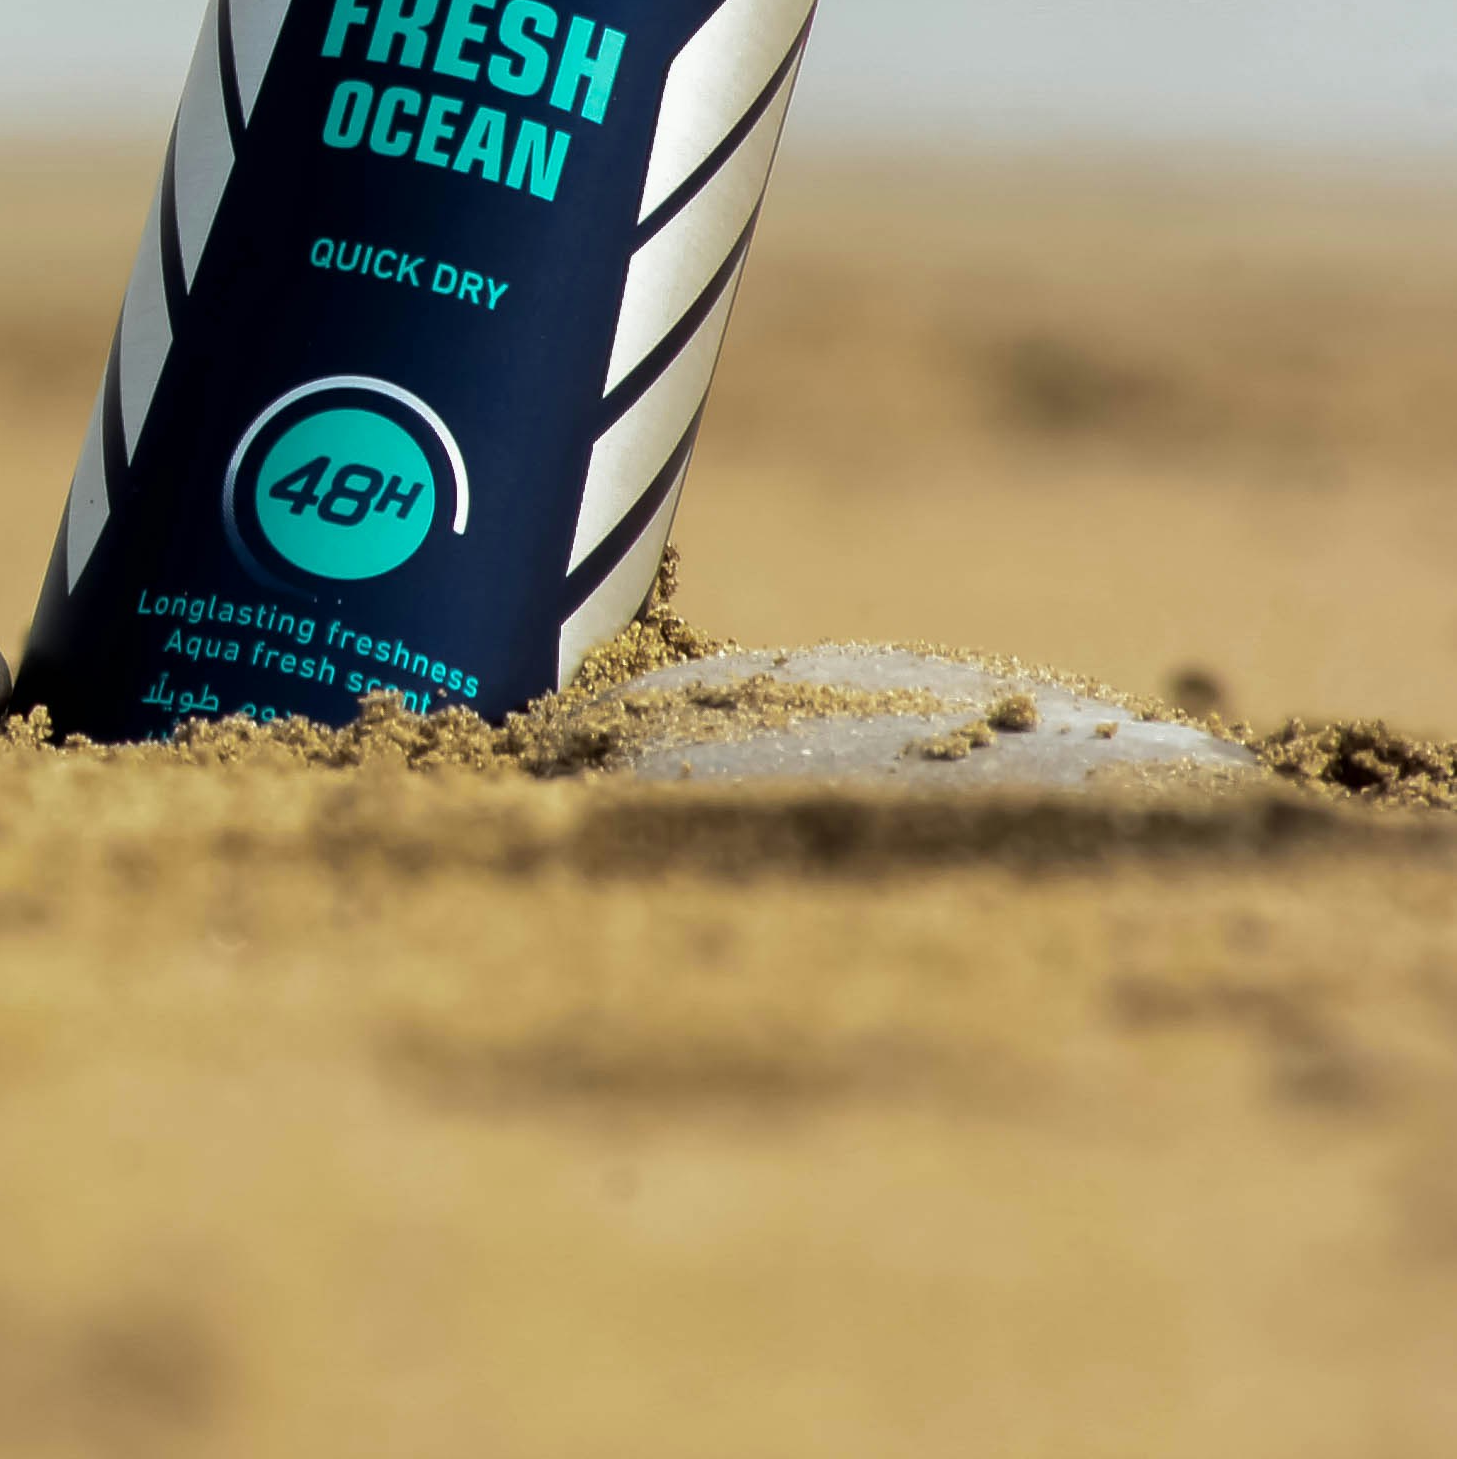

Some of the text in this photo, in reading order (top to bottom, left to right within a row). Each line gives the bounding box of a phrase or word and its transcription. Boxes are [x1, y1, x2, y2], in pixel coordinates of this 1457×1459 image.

[322, 80, 571, 202] OCEAN
[310, 237, 509, 311] QUICK DRY
[268, 455, 424, 527] 48H
[137, 589, 480, 699] Longlasting freshness
[164, 629, 240, 662] Aqua
[252, 643, 336, 685] fresh
